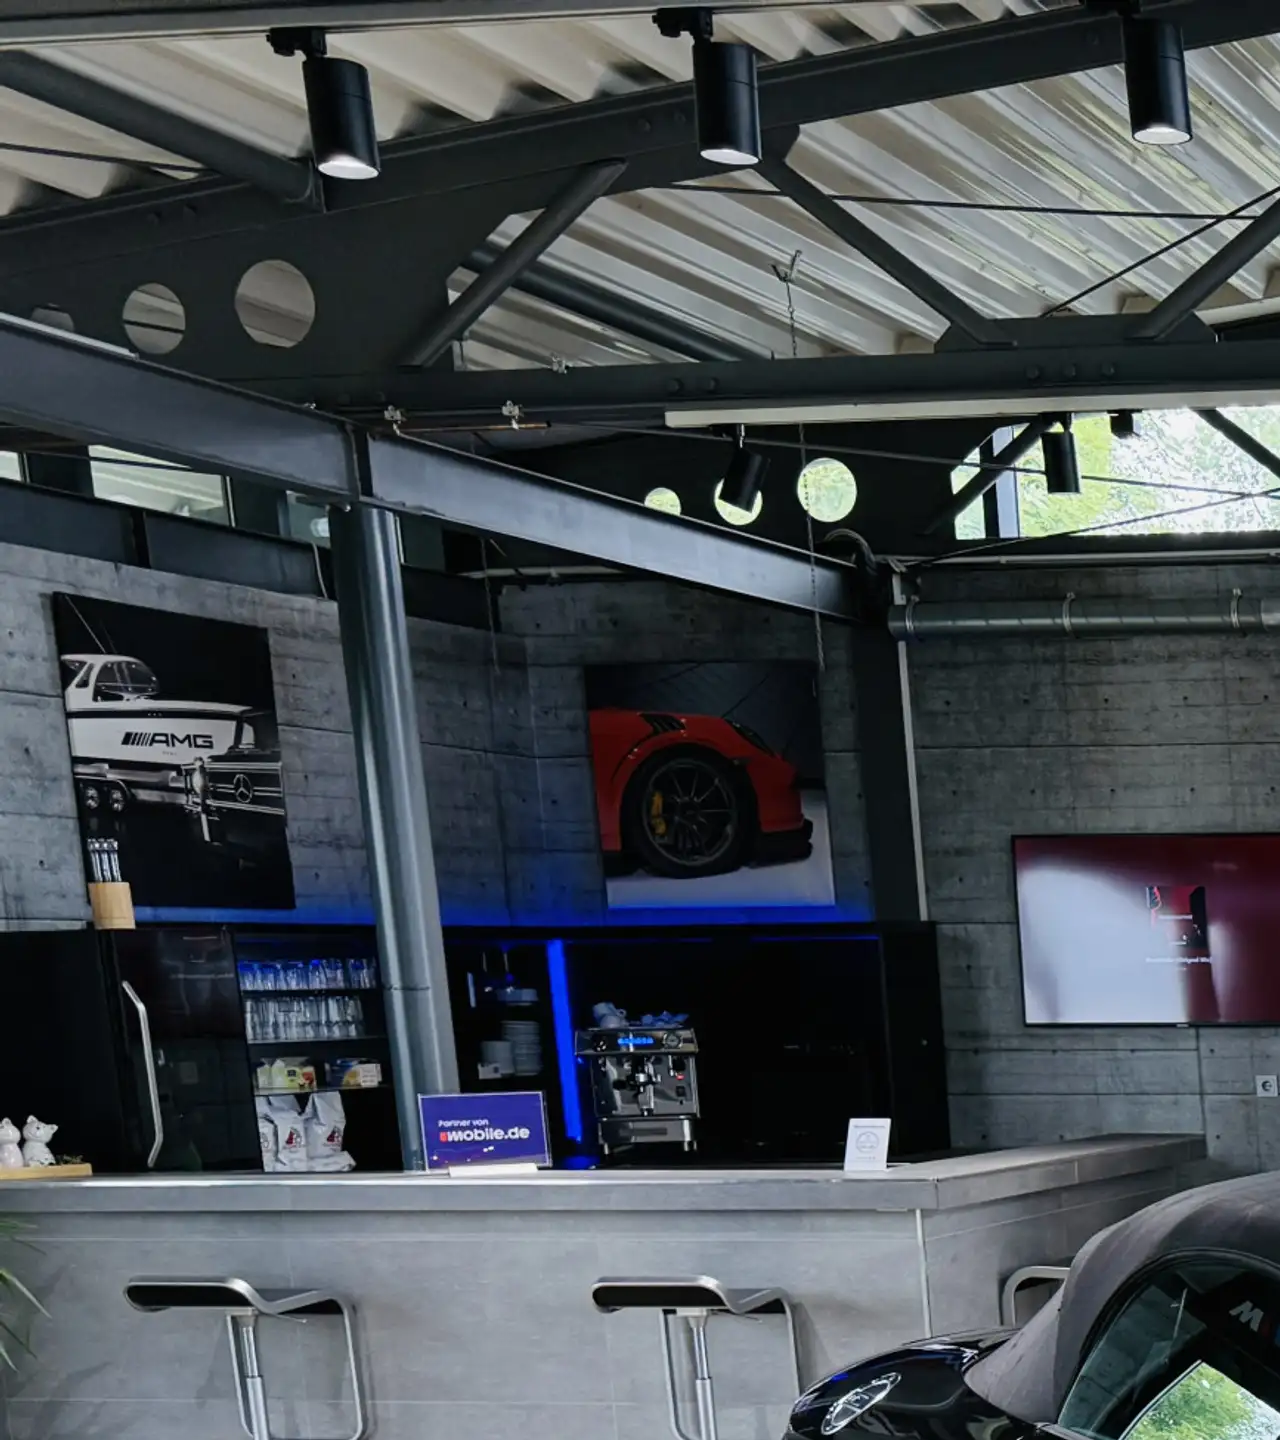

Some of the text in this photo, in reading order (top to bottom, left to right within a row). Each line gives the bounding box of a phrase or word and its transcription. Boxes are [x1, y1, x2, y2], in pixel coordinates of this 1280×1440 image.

[150, 733, 214, 749] AMG
[438, 1118, 489, 1128] Partner von
[447, 1127, 530, 1141] mobile.de
